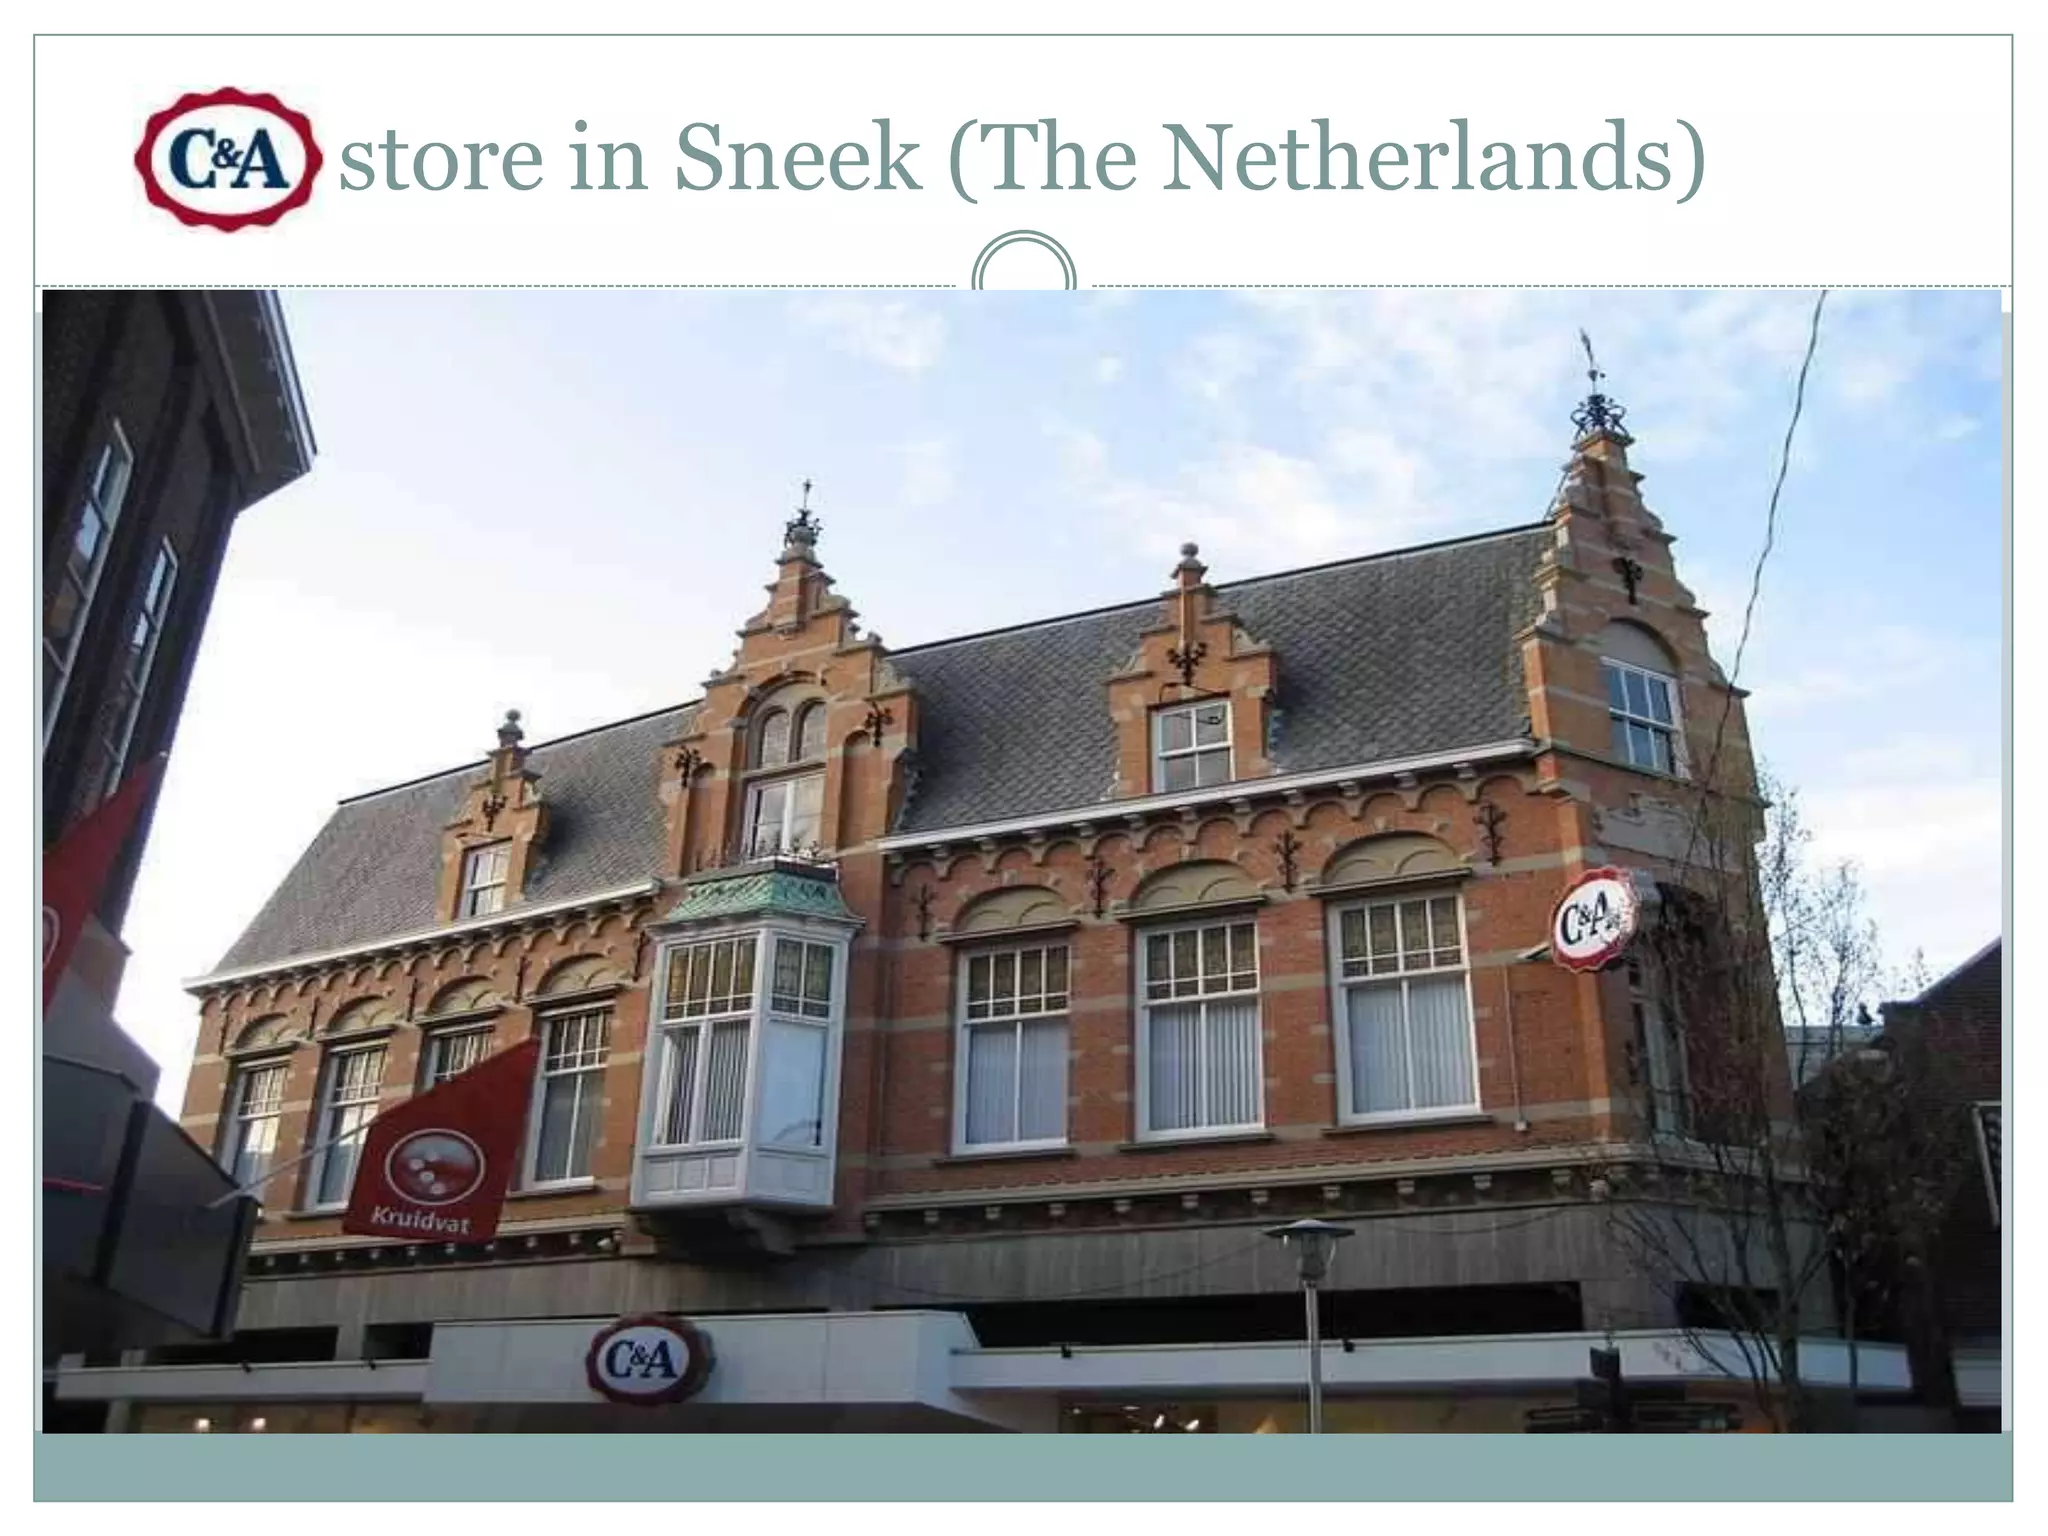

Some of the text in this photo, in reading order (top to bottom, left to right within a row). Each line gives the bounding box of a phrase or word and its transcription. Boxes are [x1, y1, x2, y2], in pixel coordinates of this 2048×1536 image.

[1560, 890, 1615, 946] C&A
[371, 1205, 472, 1236] Kruidvat
[605, 1339, 678, 1379] C&A
